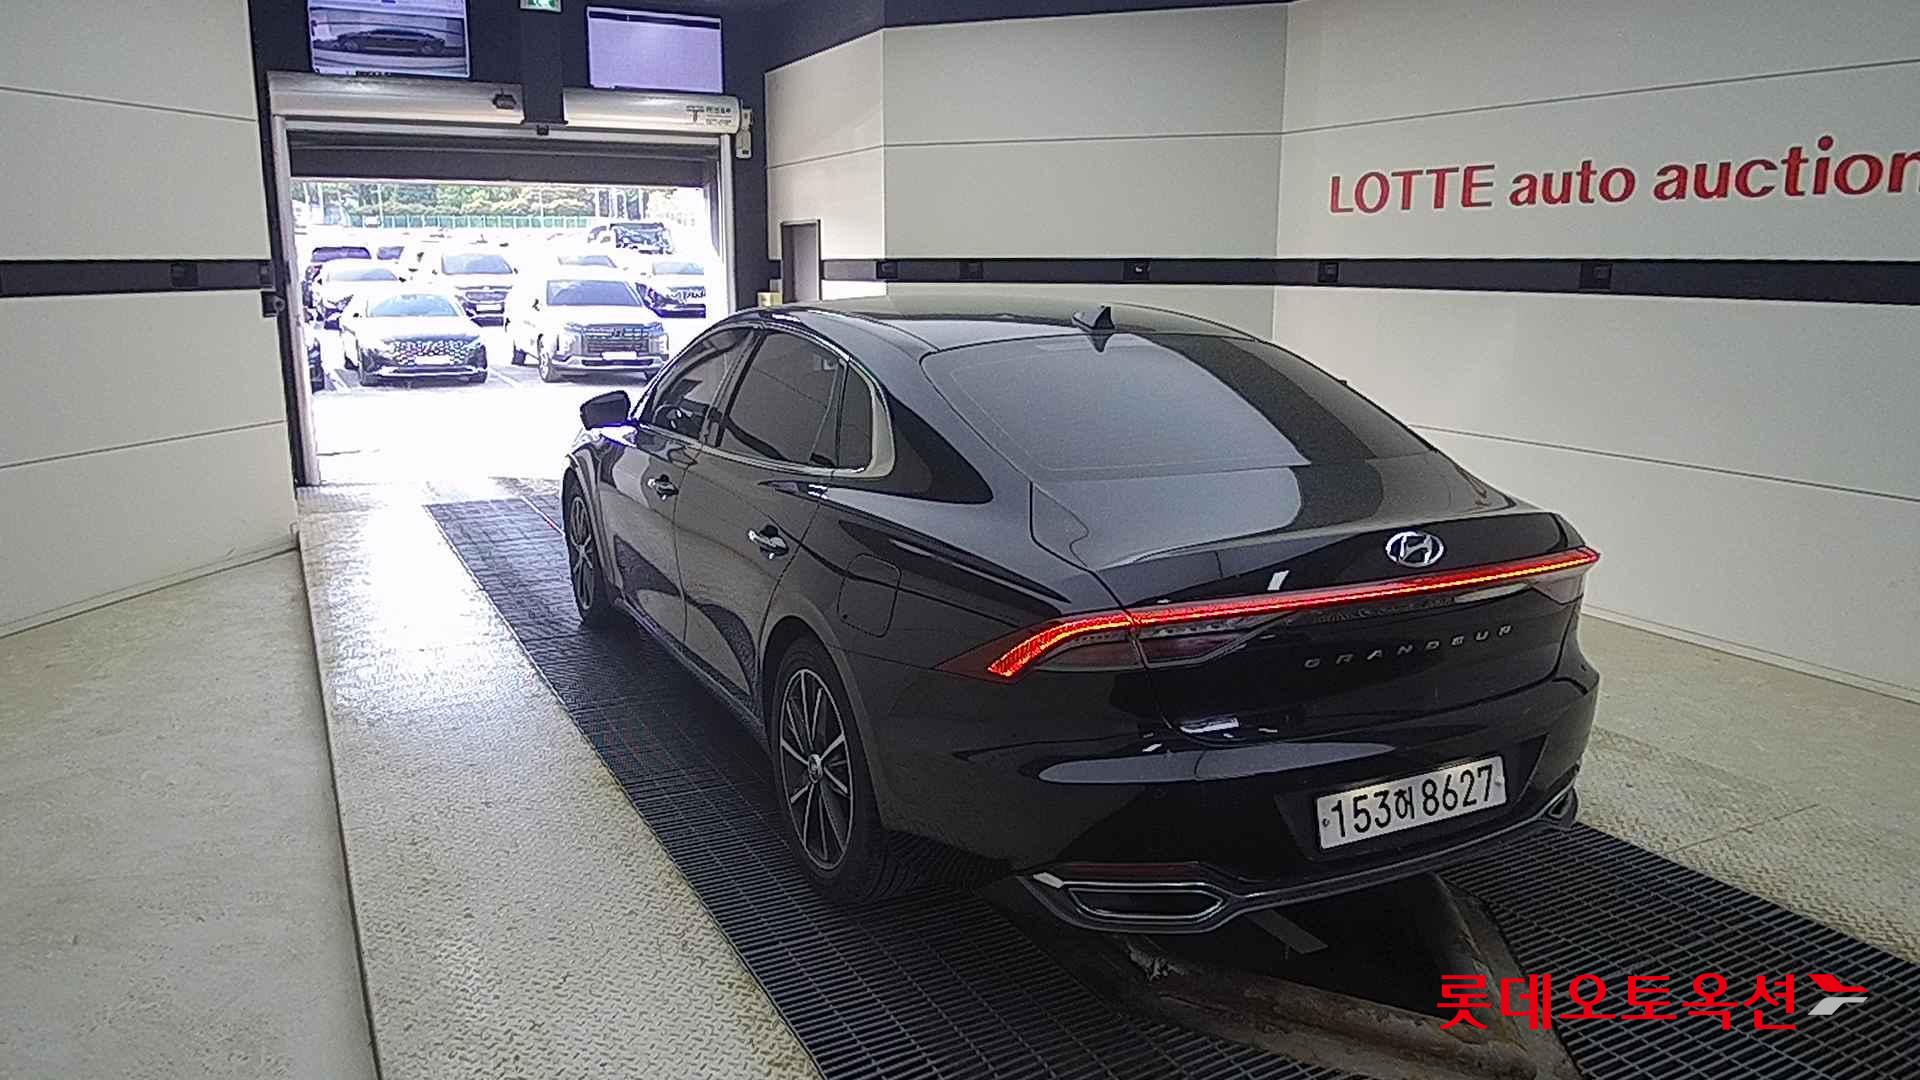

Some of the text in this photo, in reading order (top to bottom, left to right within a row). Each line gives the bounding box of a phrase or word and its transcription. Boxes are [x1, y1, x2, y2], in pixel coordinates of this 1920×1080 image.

[1330, 134, 1920, 213] LOTTE auto auction
[1304, 624, 1512, 669] GRANDEUR
